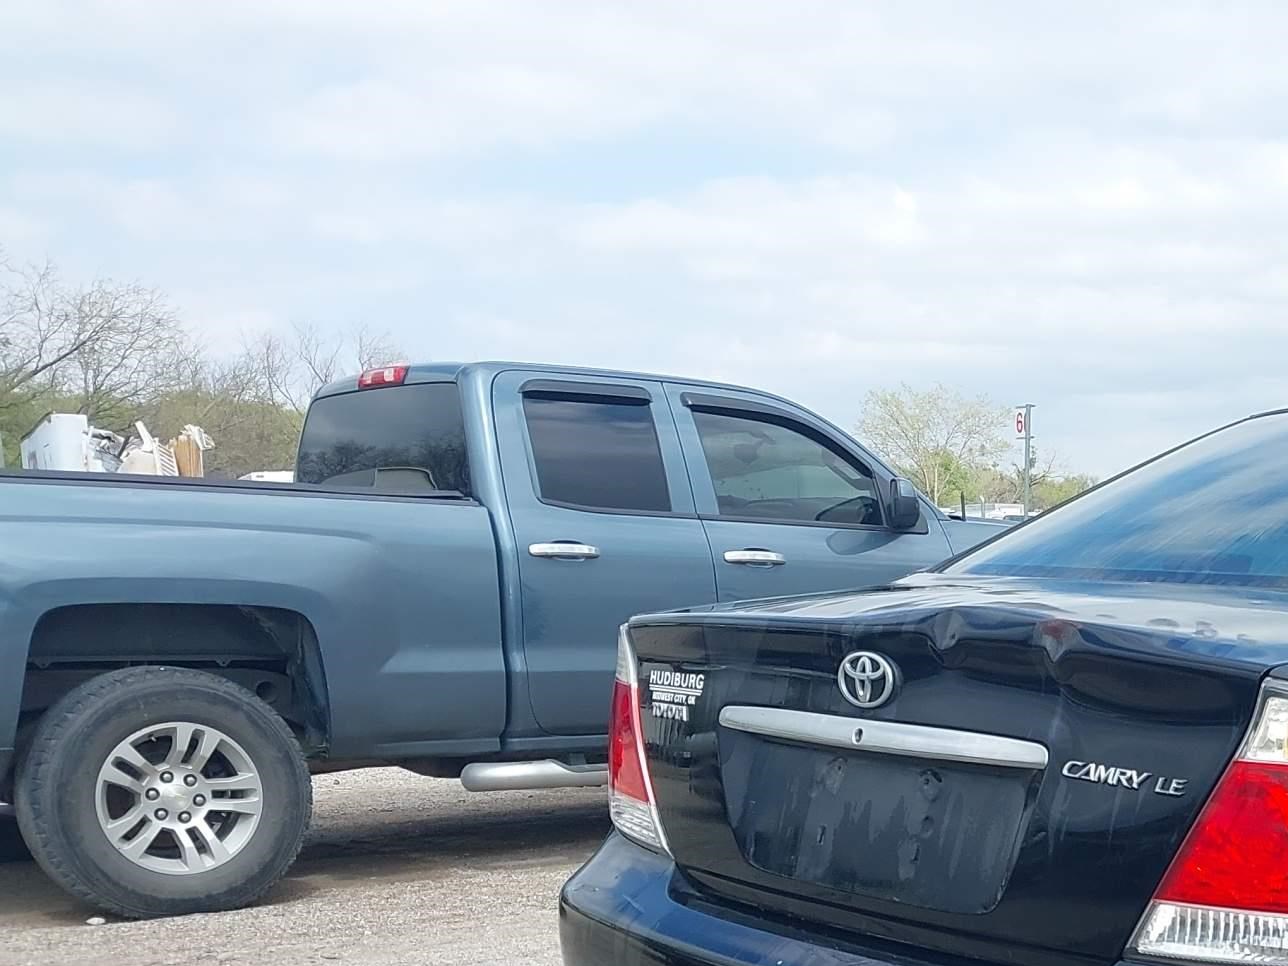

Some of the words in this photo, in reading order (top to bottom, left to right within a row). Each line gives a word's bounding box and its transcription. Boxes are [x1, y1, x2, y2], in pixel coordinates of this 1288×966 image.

[649, 670, 705, 689] HUDIBURG
[1062, 760, 1152, 789] CAMRY
[1154, 777, 1188, 796] LE
